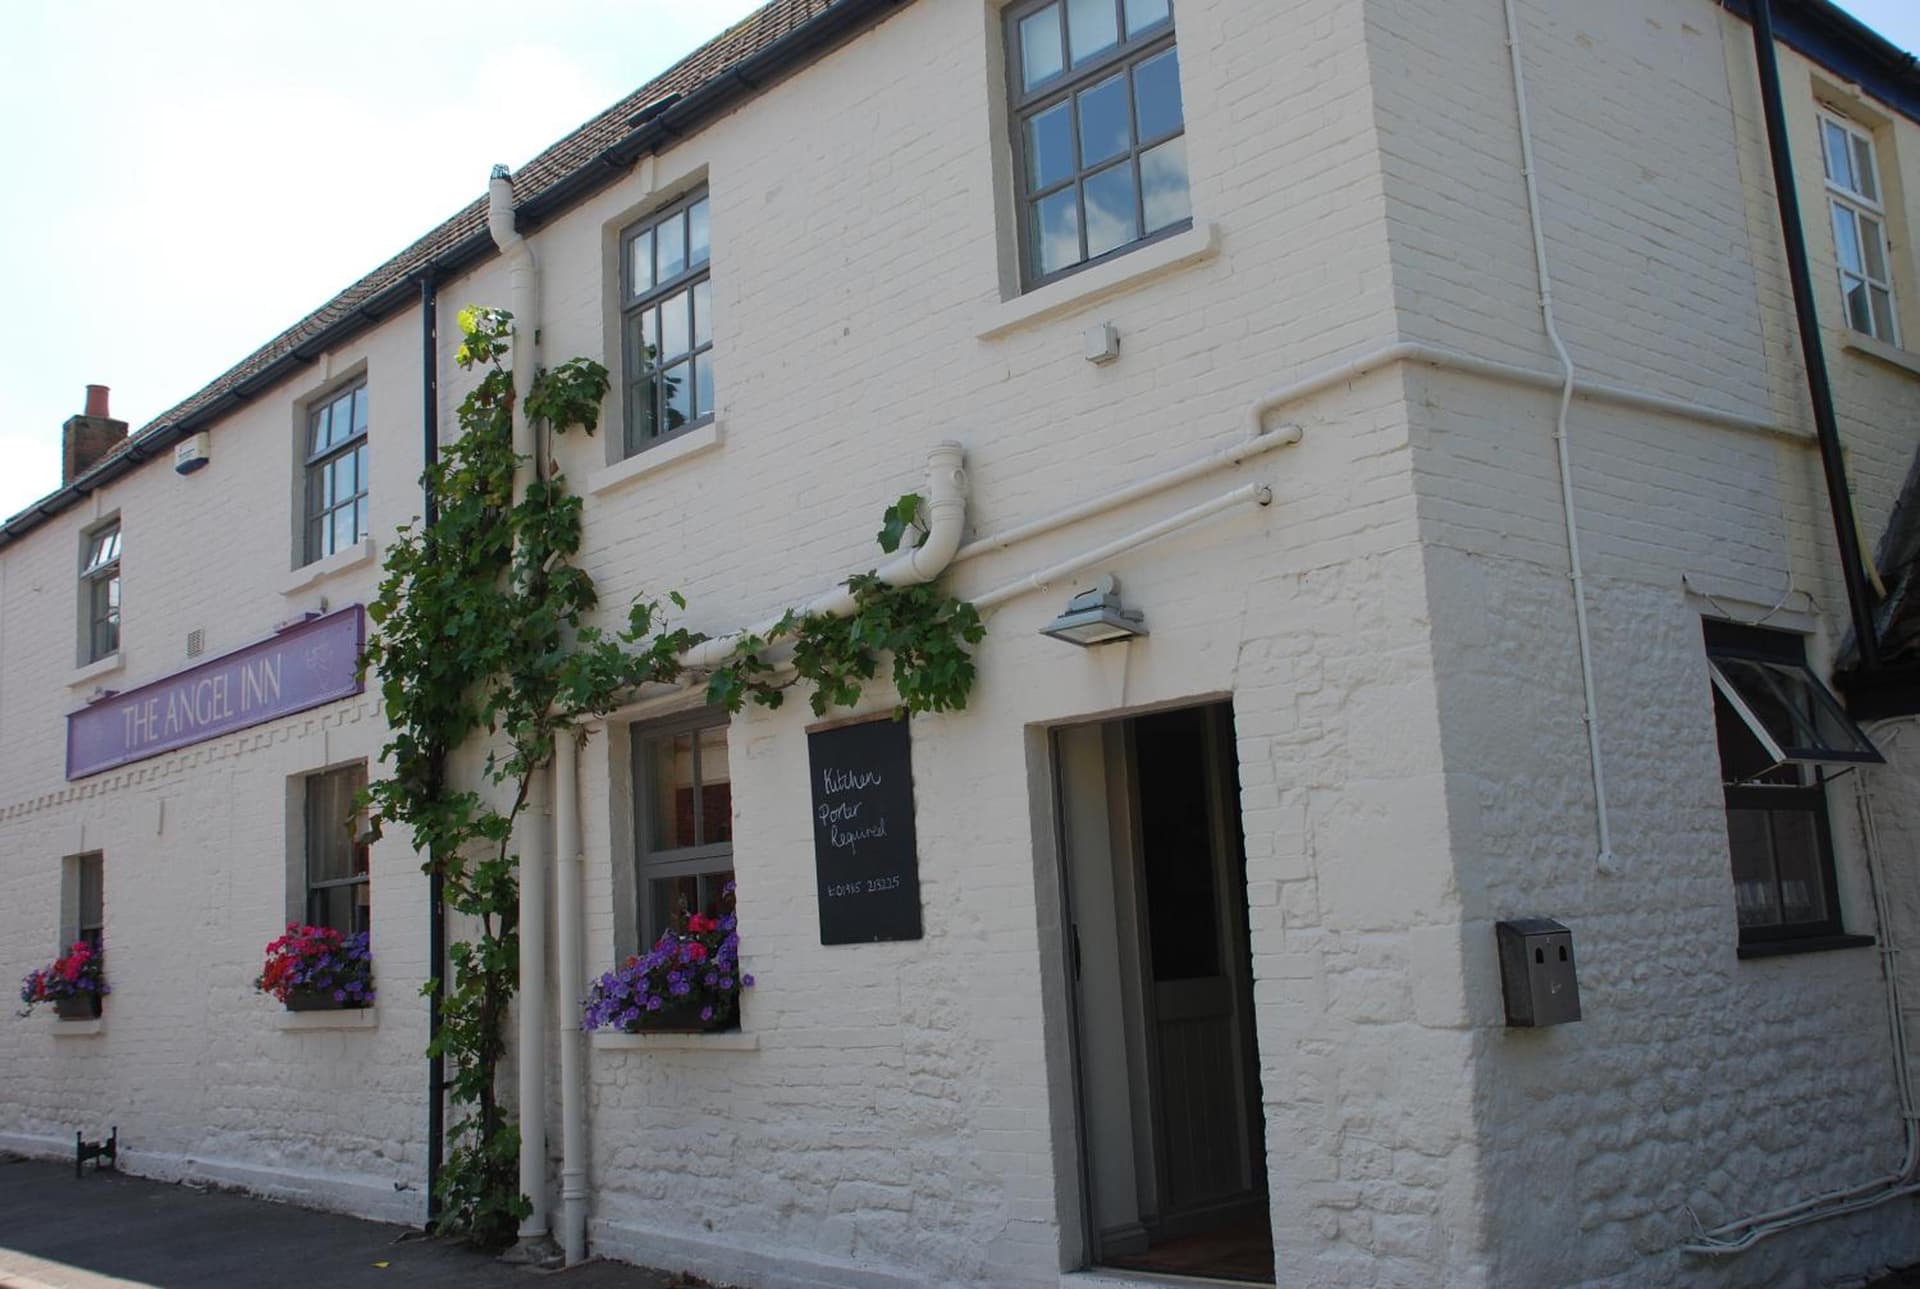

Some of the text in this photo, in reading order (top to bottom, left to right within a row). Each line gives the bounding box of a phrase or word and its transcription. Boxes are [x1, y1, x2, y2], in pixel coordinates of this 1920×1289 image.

[122, 652, 282, 749] THE ANGEL INN
[823, 767, 882, 795] Kitchen
[818, 801, 863, 827] Porter
[831, 816, 888, 856] Required
